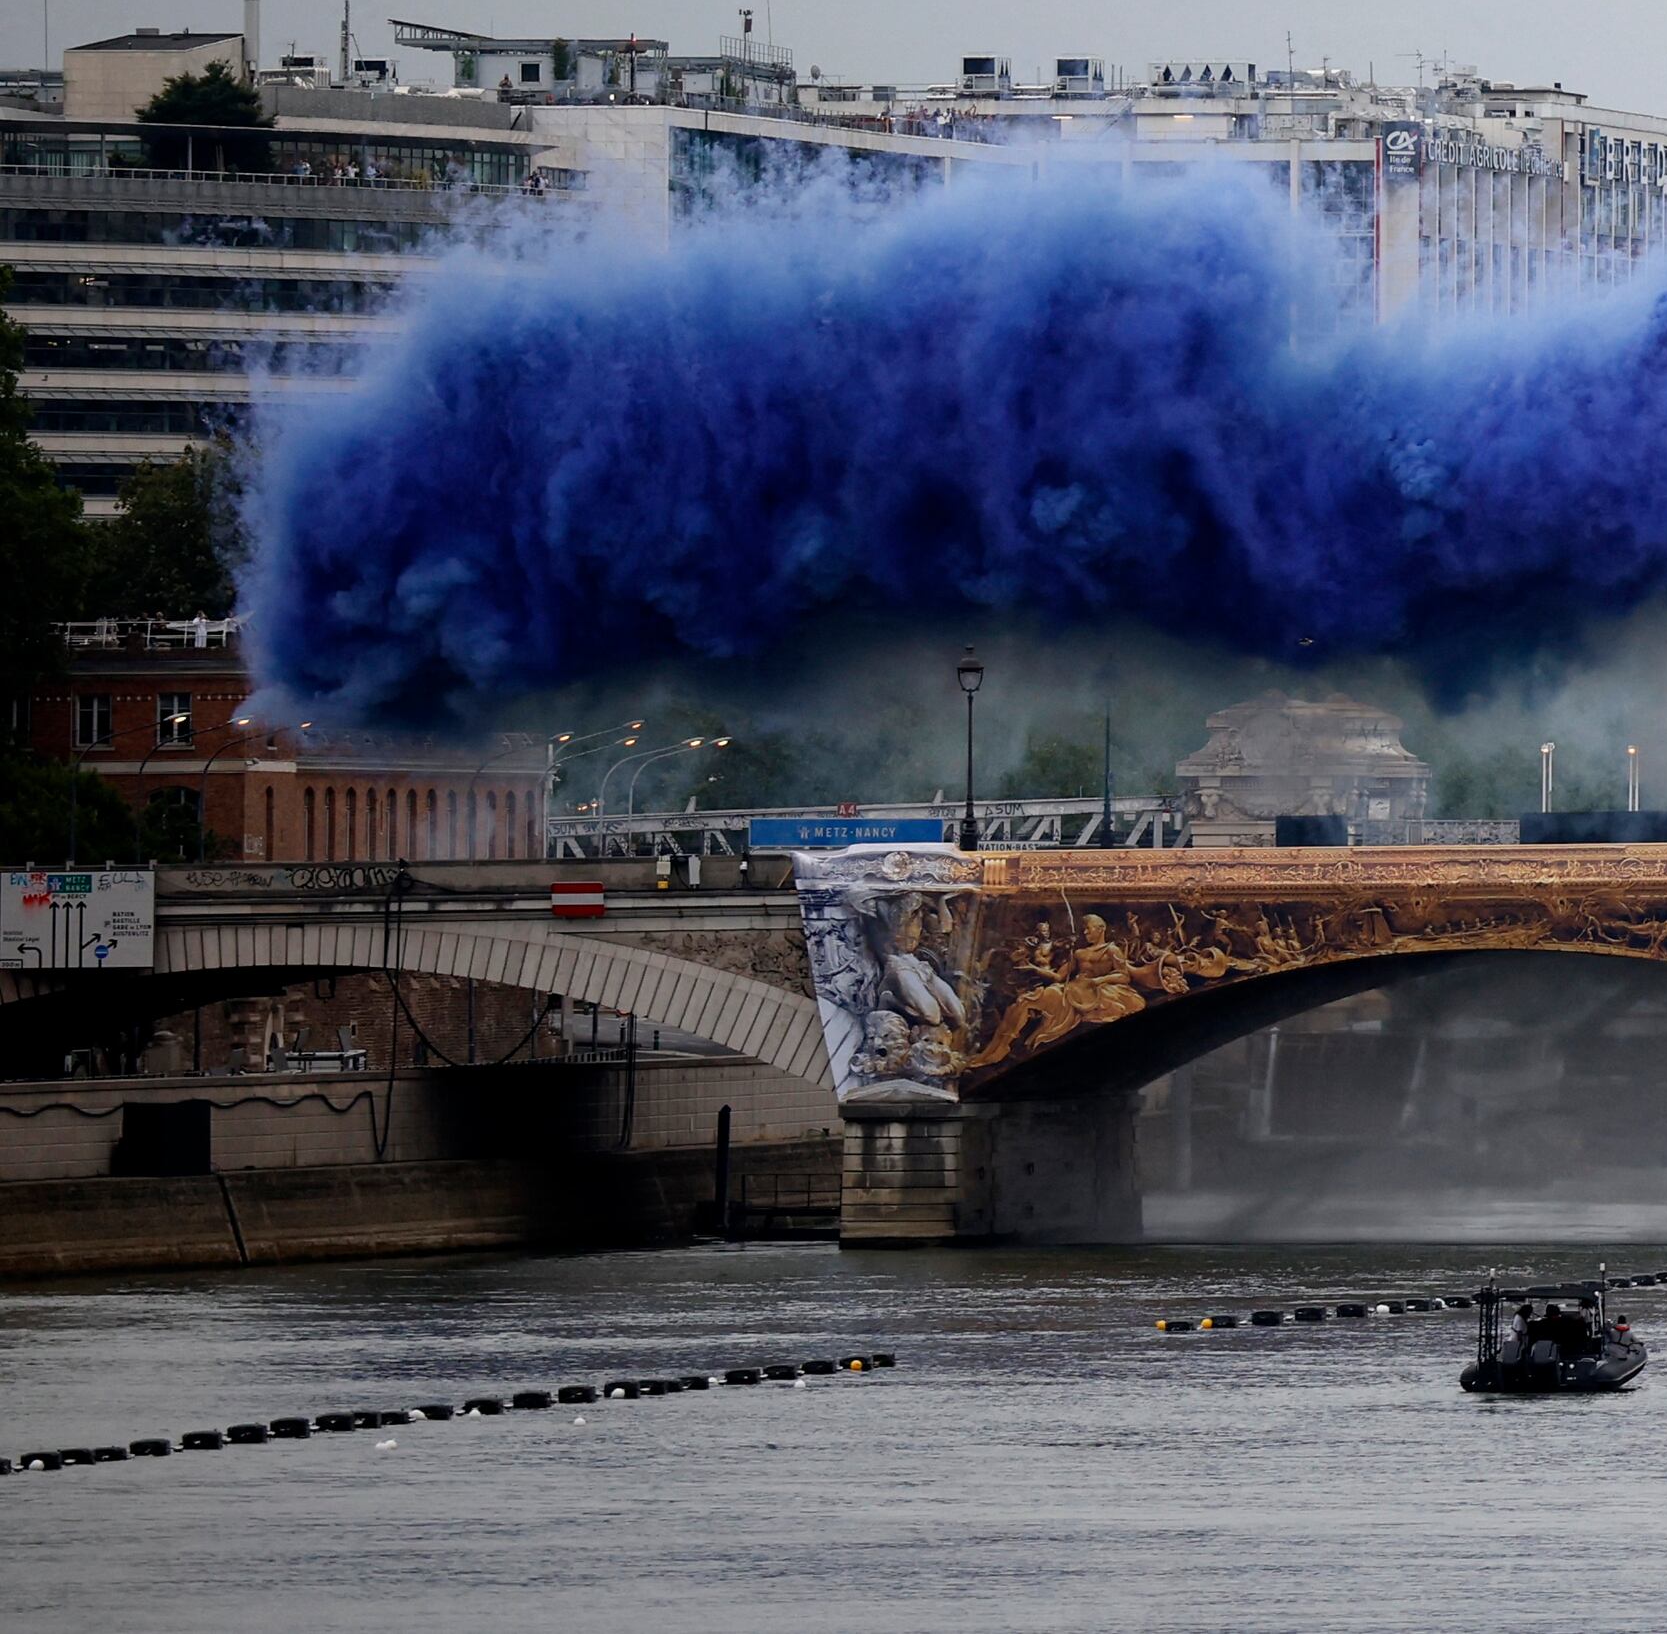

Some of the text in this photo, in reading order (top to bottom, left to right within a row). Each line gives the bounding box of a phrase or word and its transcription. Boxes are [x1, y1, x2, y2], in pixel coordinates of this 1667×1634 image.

[1389, 165, 1415, 174] France
[1470, 145, 1518, 171] AGRICOLE
[1606, 140, 1666, 187] BRED
